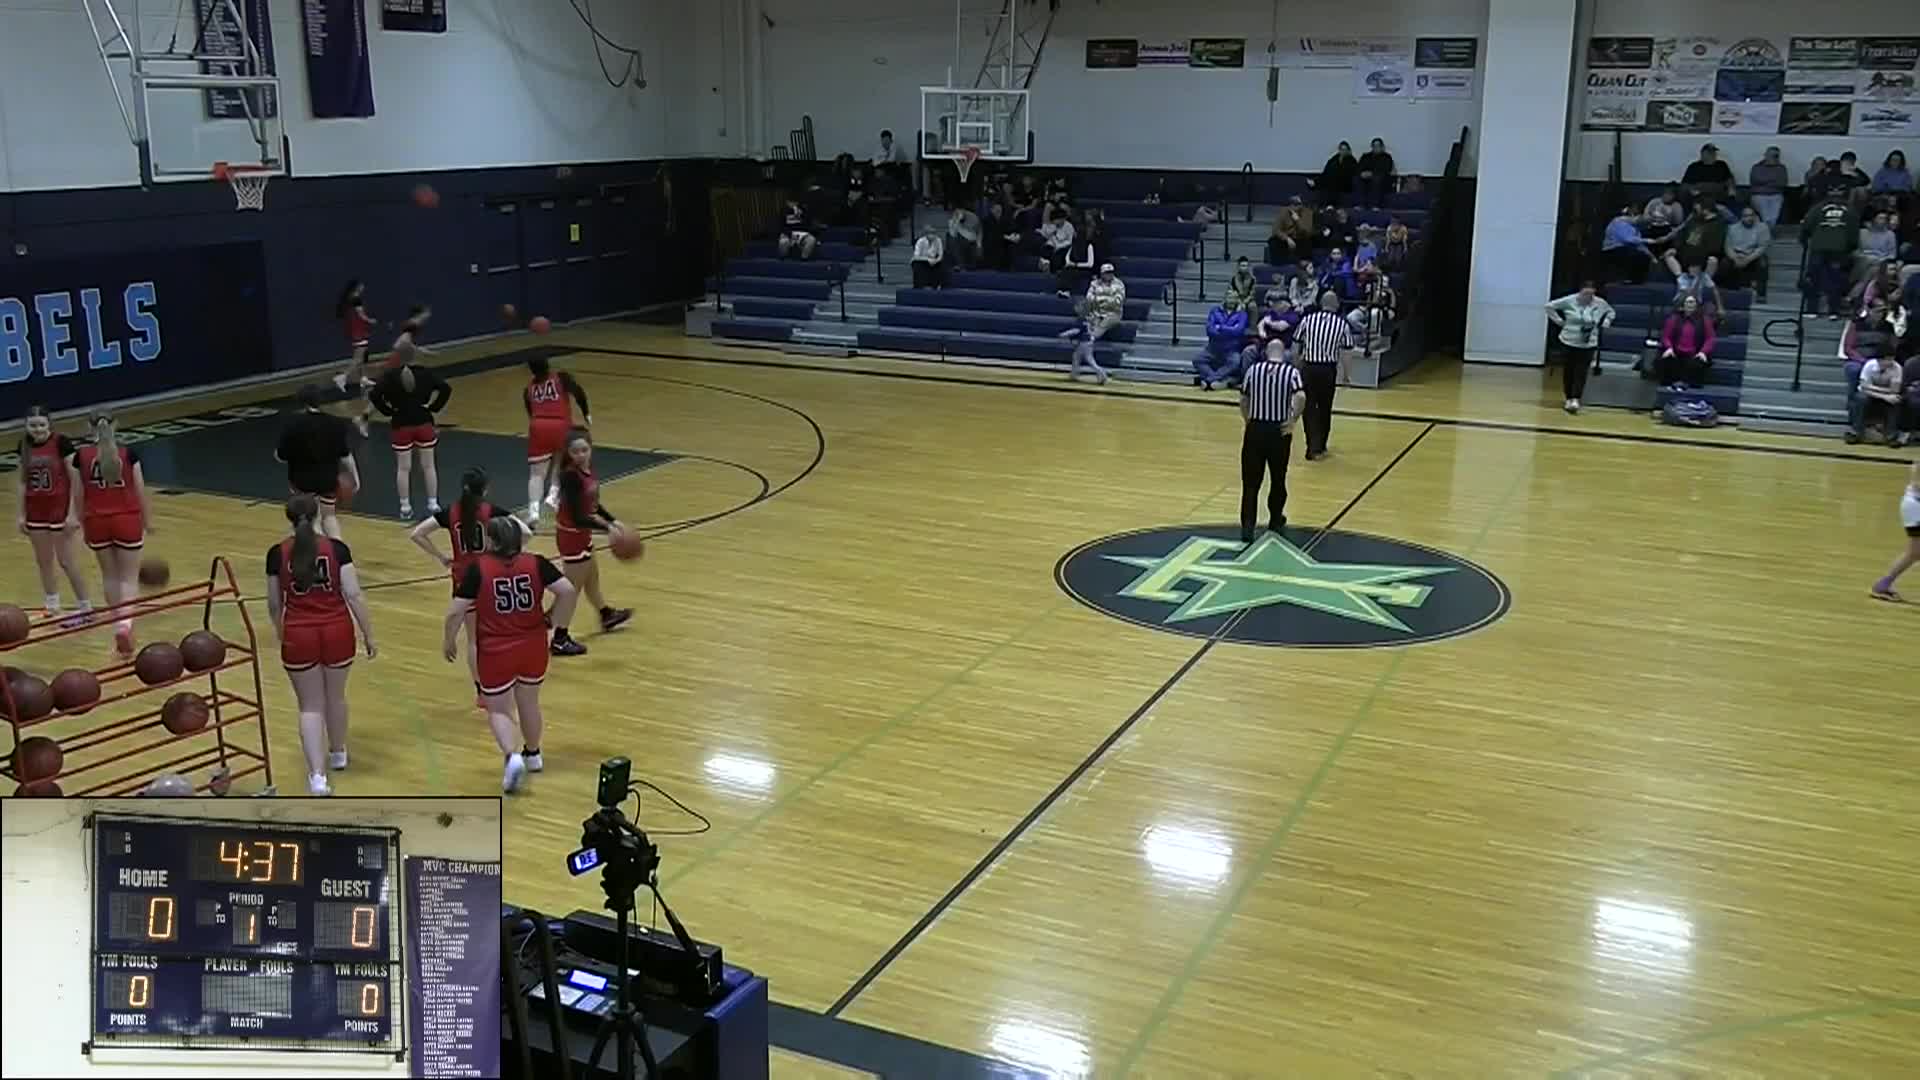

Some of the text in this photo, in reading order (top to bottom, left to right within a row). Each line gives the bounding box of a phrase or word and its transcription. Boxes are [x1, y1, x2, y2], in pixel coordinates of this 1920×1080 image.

[0, 281, 162, 383] BELS
[532, 379, 560, 402] 44
[492, 575, 535, 614] 55
[219, 840, 299, 882] 4:37
[423, 859, 445, 872] MVC
[119, 867, 169, 888] HOME
[321, 877, 372, 898] GUEST
[228, 892, 264, 905] PERIOD
[148, 896, 173, 938] 0
[248, 913, 255, 942] 1
[351, 906, 375, 948] 0
[100, 954, 158, 969] TM FOULS
[204, 957, 294, 975] PLAYER FOULS
[334, 963, 388, 978] TM FOULS
[129, 975, 148, 1007] 0
[361, 983, 380, 1014] 0
[110, 1013, 147, 1026] POINTS
[230, 1016, 264, 1029] MATCH
[344, 1020, 379, 1033] POINTS
